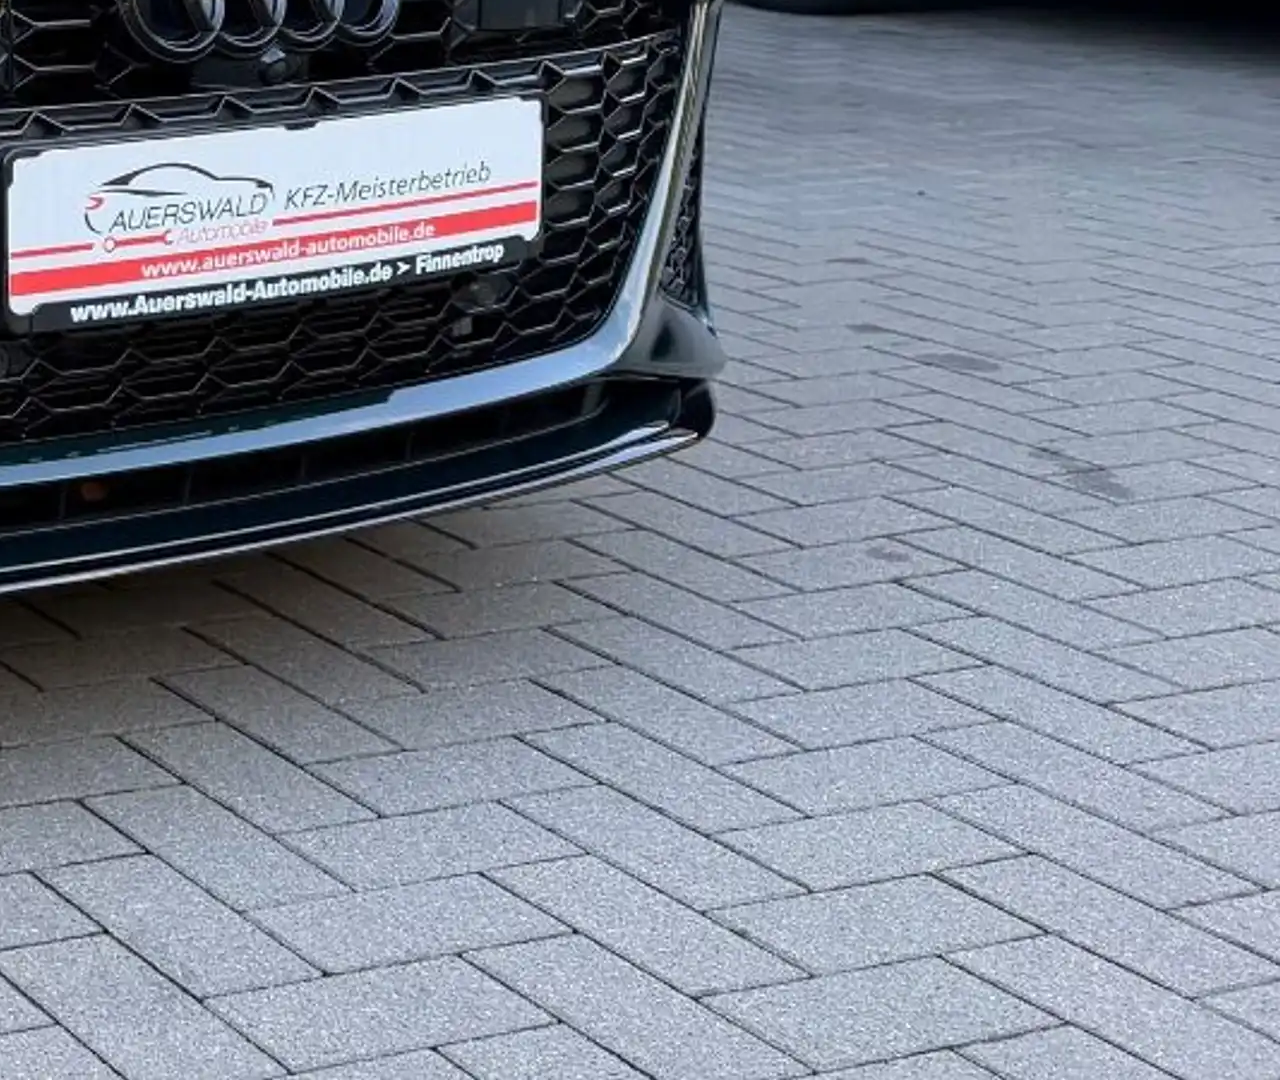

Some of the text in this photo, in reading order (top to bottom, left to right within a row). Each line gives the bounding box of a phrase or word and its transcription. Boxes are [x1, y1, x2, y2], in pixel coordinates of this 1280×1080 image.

[284, 160, 491, 210] KFZ-Meisterbetrieb
[109, 193, 268, 233] AUERSWALD
[141, 222, 436, 278] www.auerswald-automobile.de
[70, 260, 393, 322] www.Auerswald-Automobile.de
[415, 243, 504, 274] Finnentrop
